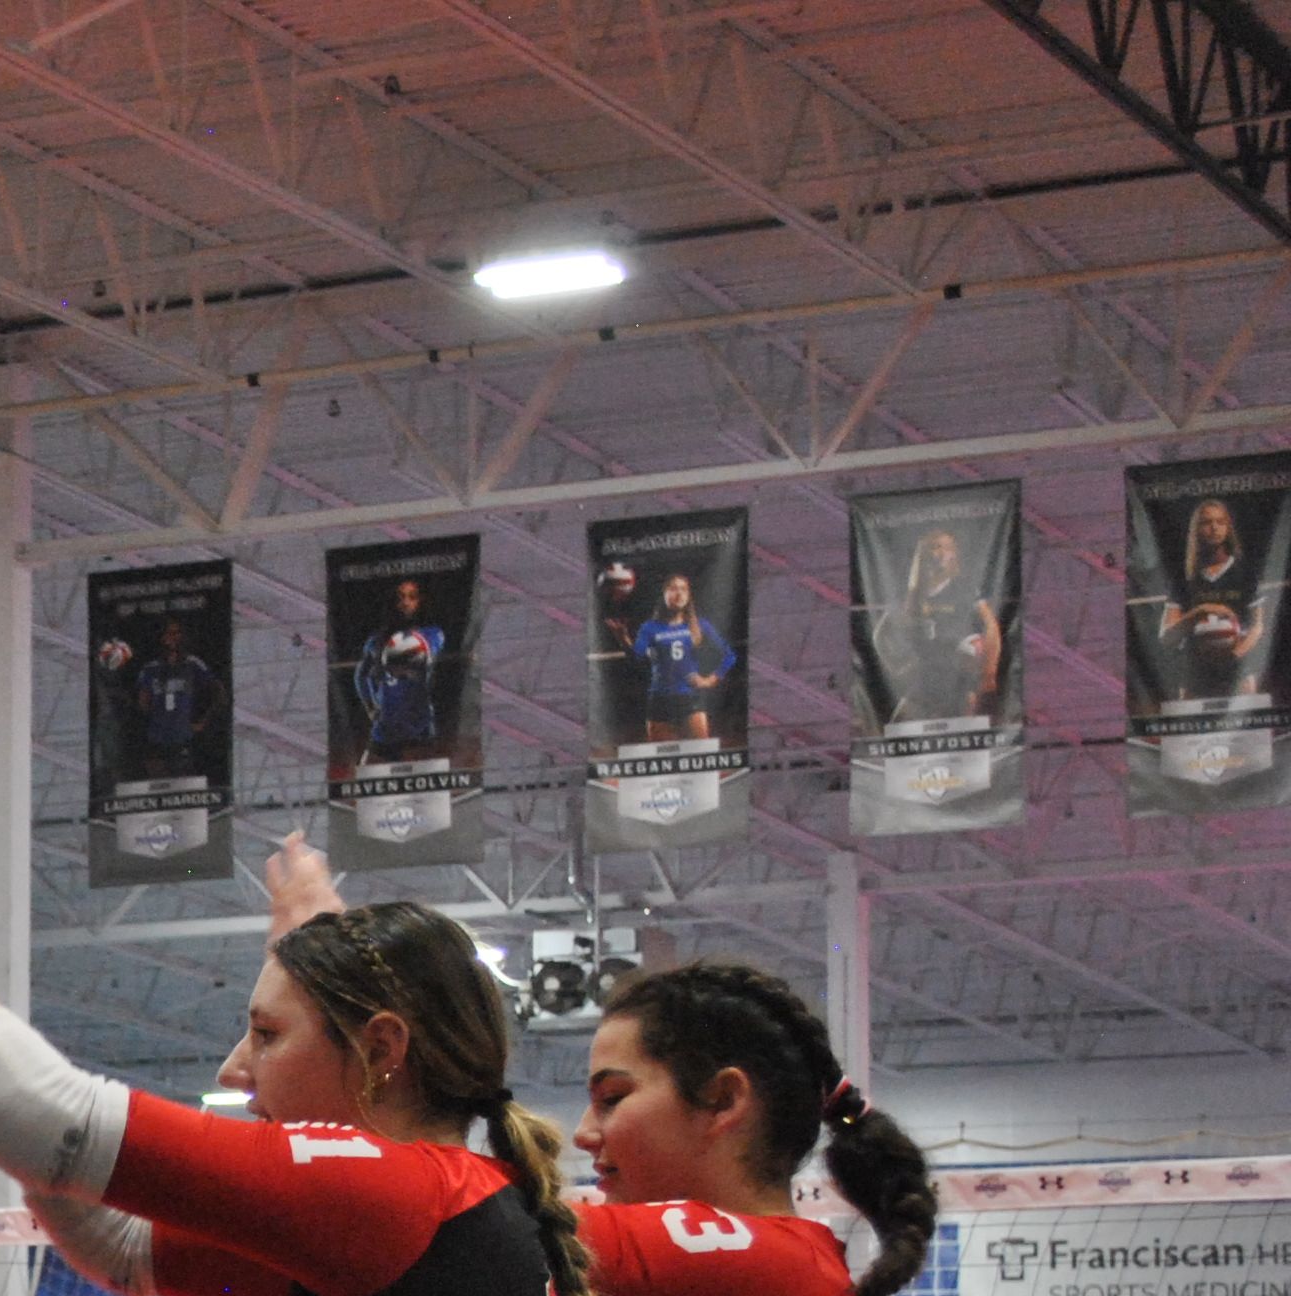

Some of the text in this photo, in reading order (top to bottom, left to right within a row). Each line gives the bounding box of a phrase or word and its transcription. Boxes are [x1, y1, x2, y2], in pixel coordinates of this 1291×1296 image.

[597, 752, 743, 776] RAEGAN BURNS
[341, 774, 470, 796] RAVEN COLVIN
[1048, 1237, 1245, 1270] Franciscan
